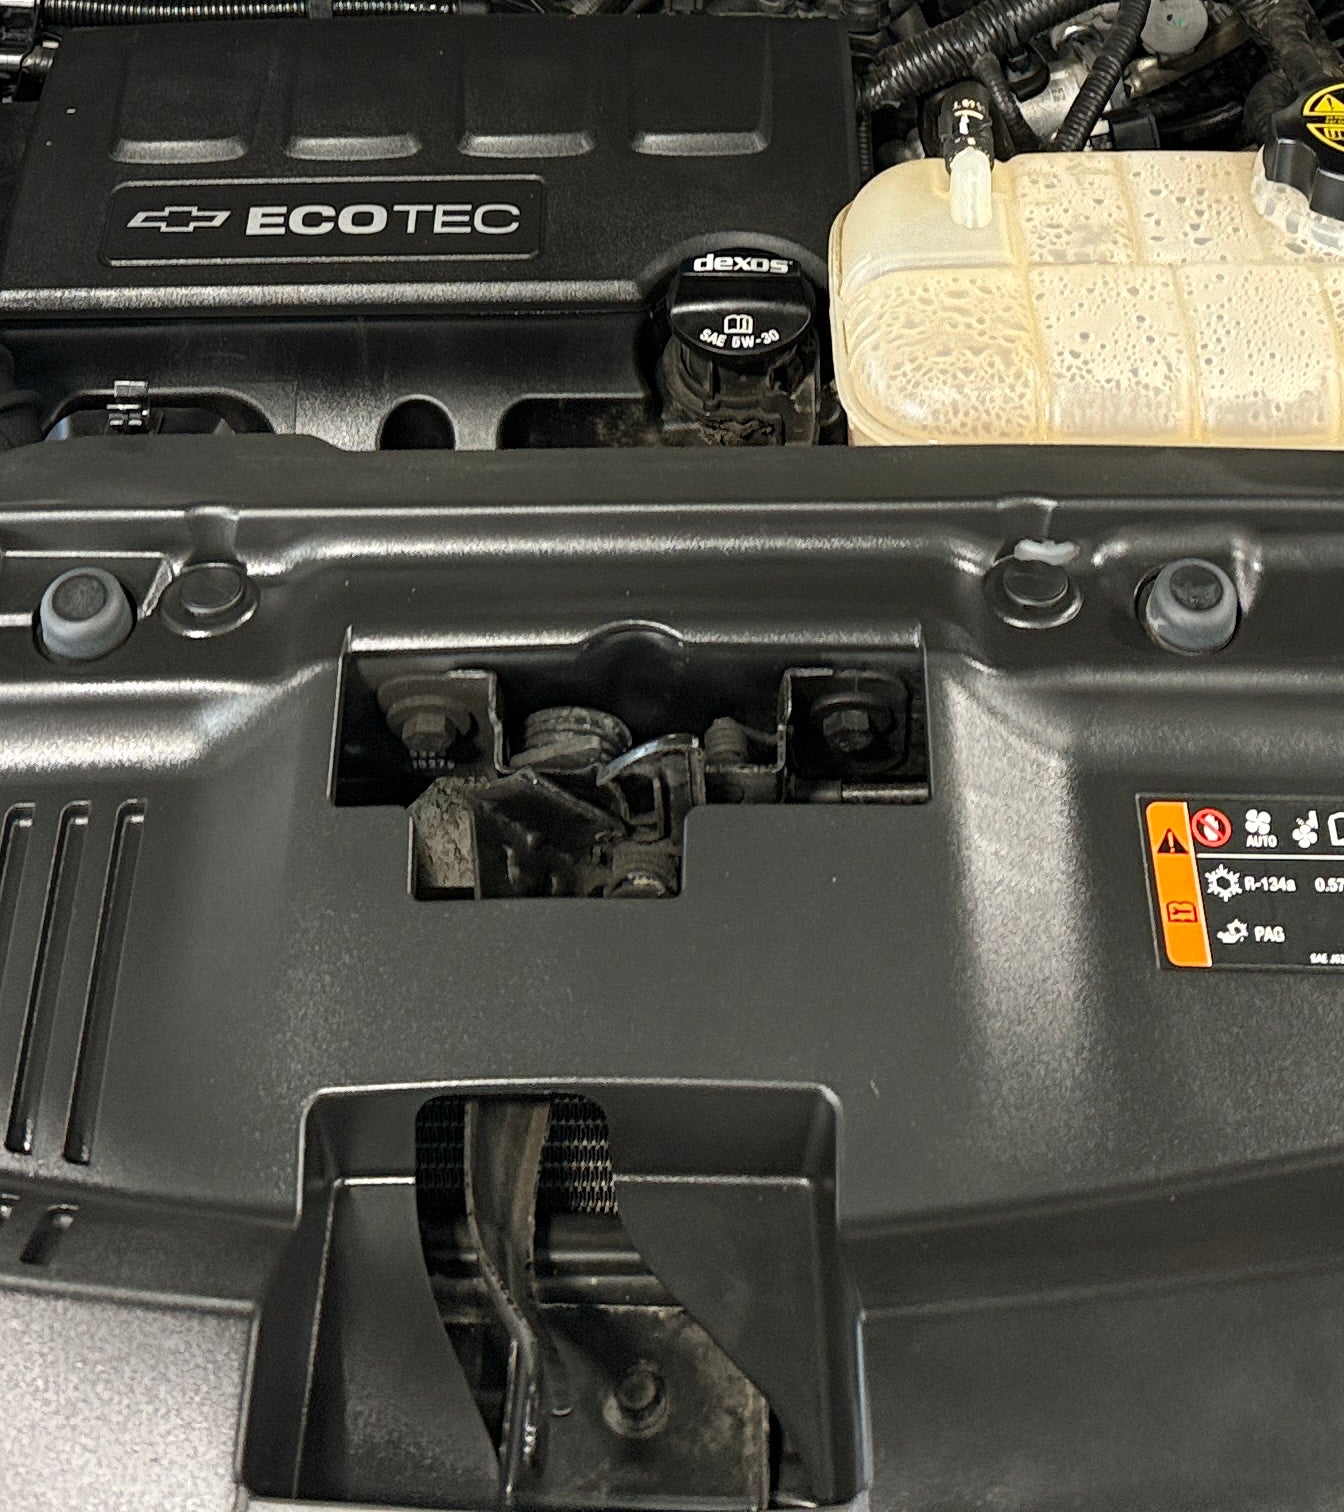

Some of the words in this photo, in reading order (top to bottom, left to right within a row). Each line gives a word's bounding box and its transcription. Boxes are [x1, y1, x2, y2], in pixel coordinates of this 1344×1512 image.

[245, 204, 520, 235] ECOTEC
[693, 253, 789, 274] dexos
[699, 328, 727, 347] SAE
[731, 329, 780, 349] 5W-30
[1246, 834, 1278, 848] AUTO
[1244, 875, 1297, 892] R-134a
[1254, 926, 1286, 943] PAG
